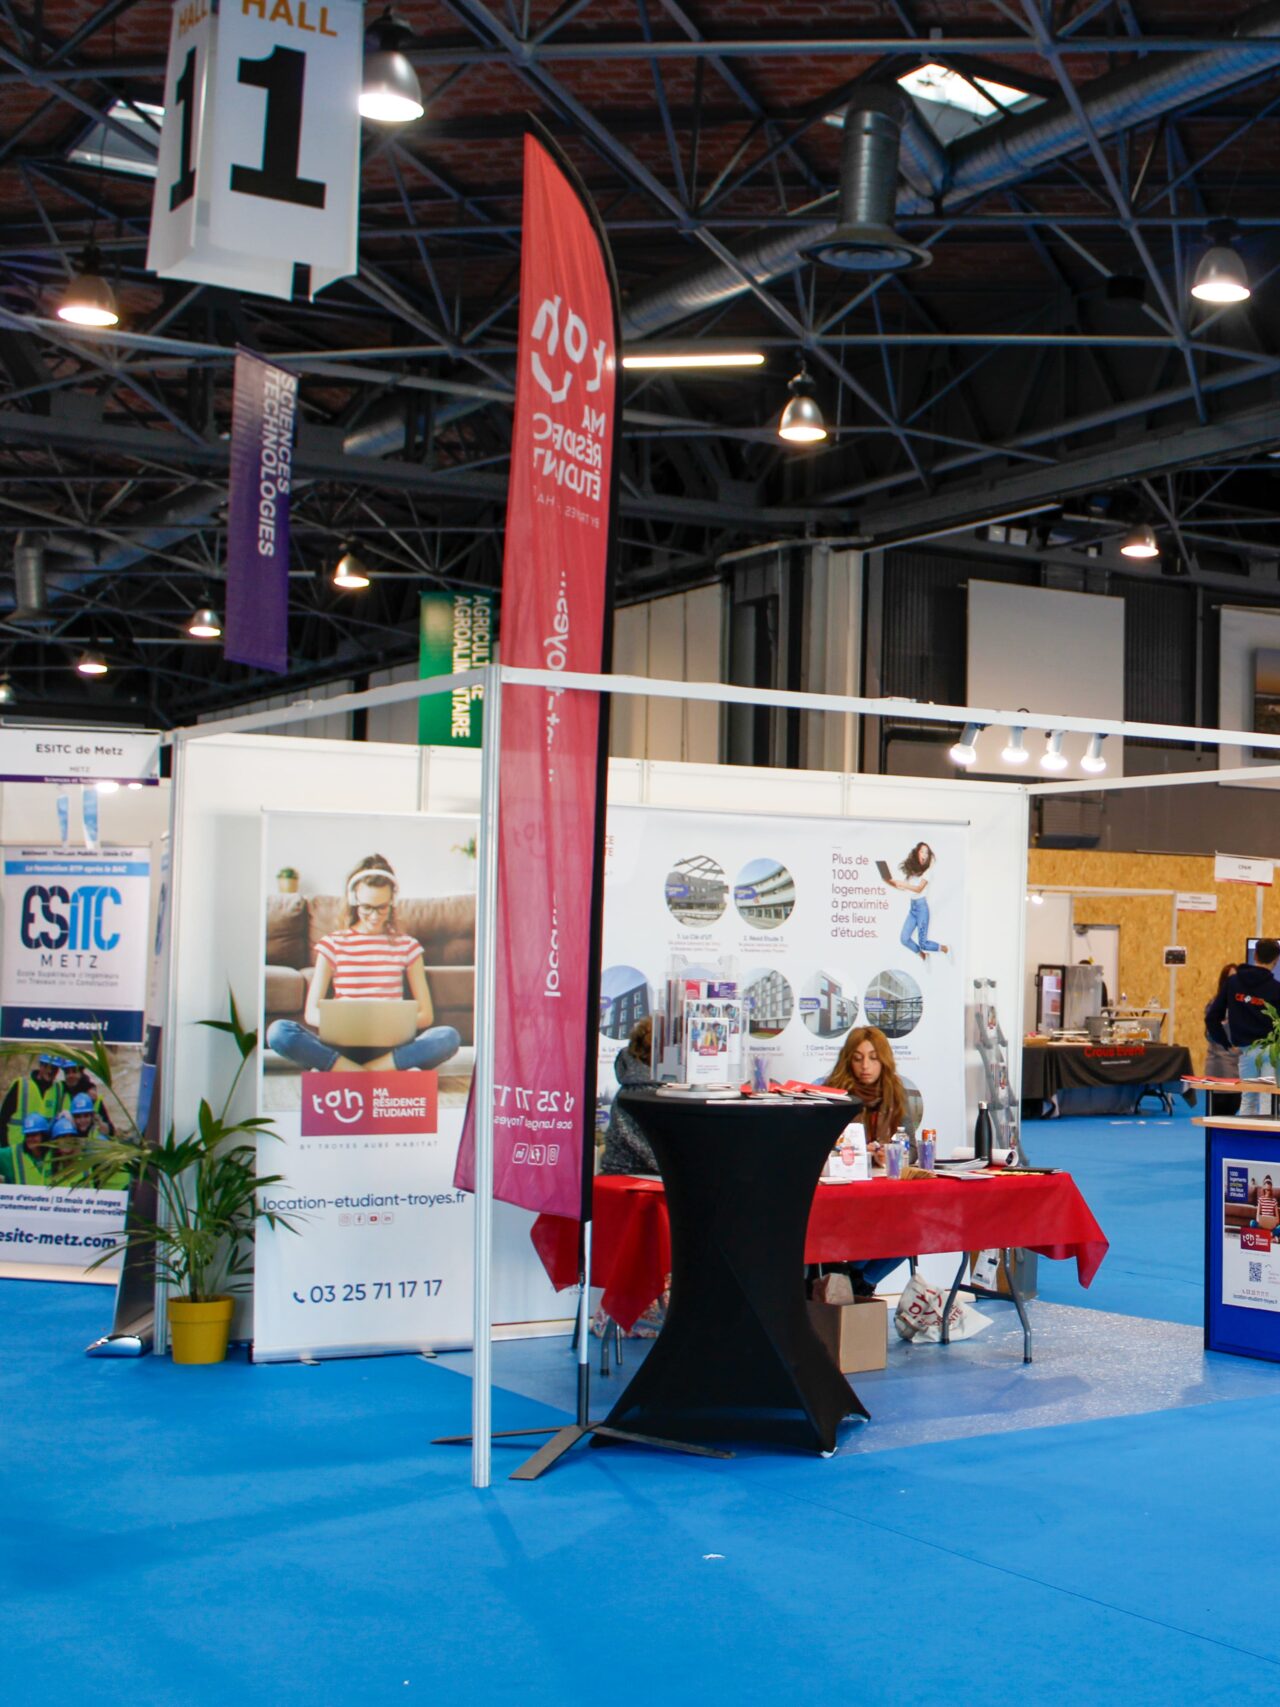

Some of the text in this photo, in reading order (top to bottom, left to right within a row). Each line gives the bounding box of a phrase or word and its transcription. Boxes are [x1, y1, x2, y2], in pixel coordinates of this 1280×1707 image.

[242, 0, 337, 37] HALL
[169, 46, 198, 212] 1
[230, 44, 326, 209] 1
[276, 371, 297, 494] SCIENCES
[257, 370, 279, 557] TECHNOLOGIES
[471, 594, 491, 700] AGRICULTRE
[452, 594, 472, 738] AGROALIMNTAIRE
[36, 744, 123, 756] ESITC de Metz
[832, 853, 869, 865] Plus de
[832, 868, 858, 880] 1000
[831, 883, 886, 897] logements
[841, 898, 889, 911] proximité
[831, 912, 877, 924] des lieux
[41, 954, 98, 968] METZ
[373, 1088, 389, 1096] MA
[373, 1096, 426, 1107] RÉSIDENCE
[373, 1106, 426, 1118] ÉTUDIANTE
[263, 1190, 467, 1210] location-etudiant-troyes.fr
[310, 1279, 443, 1303] 03 25 71 17 17
